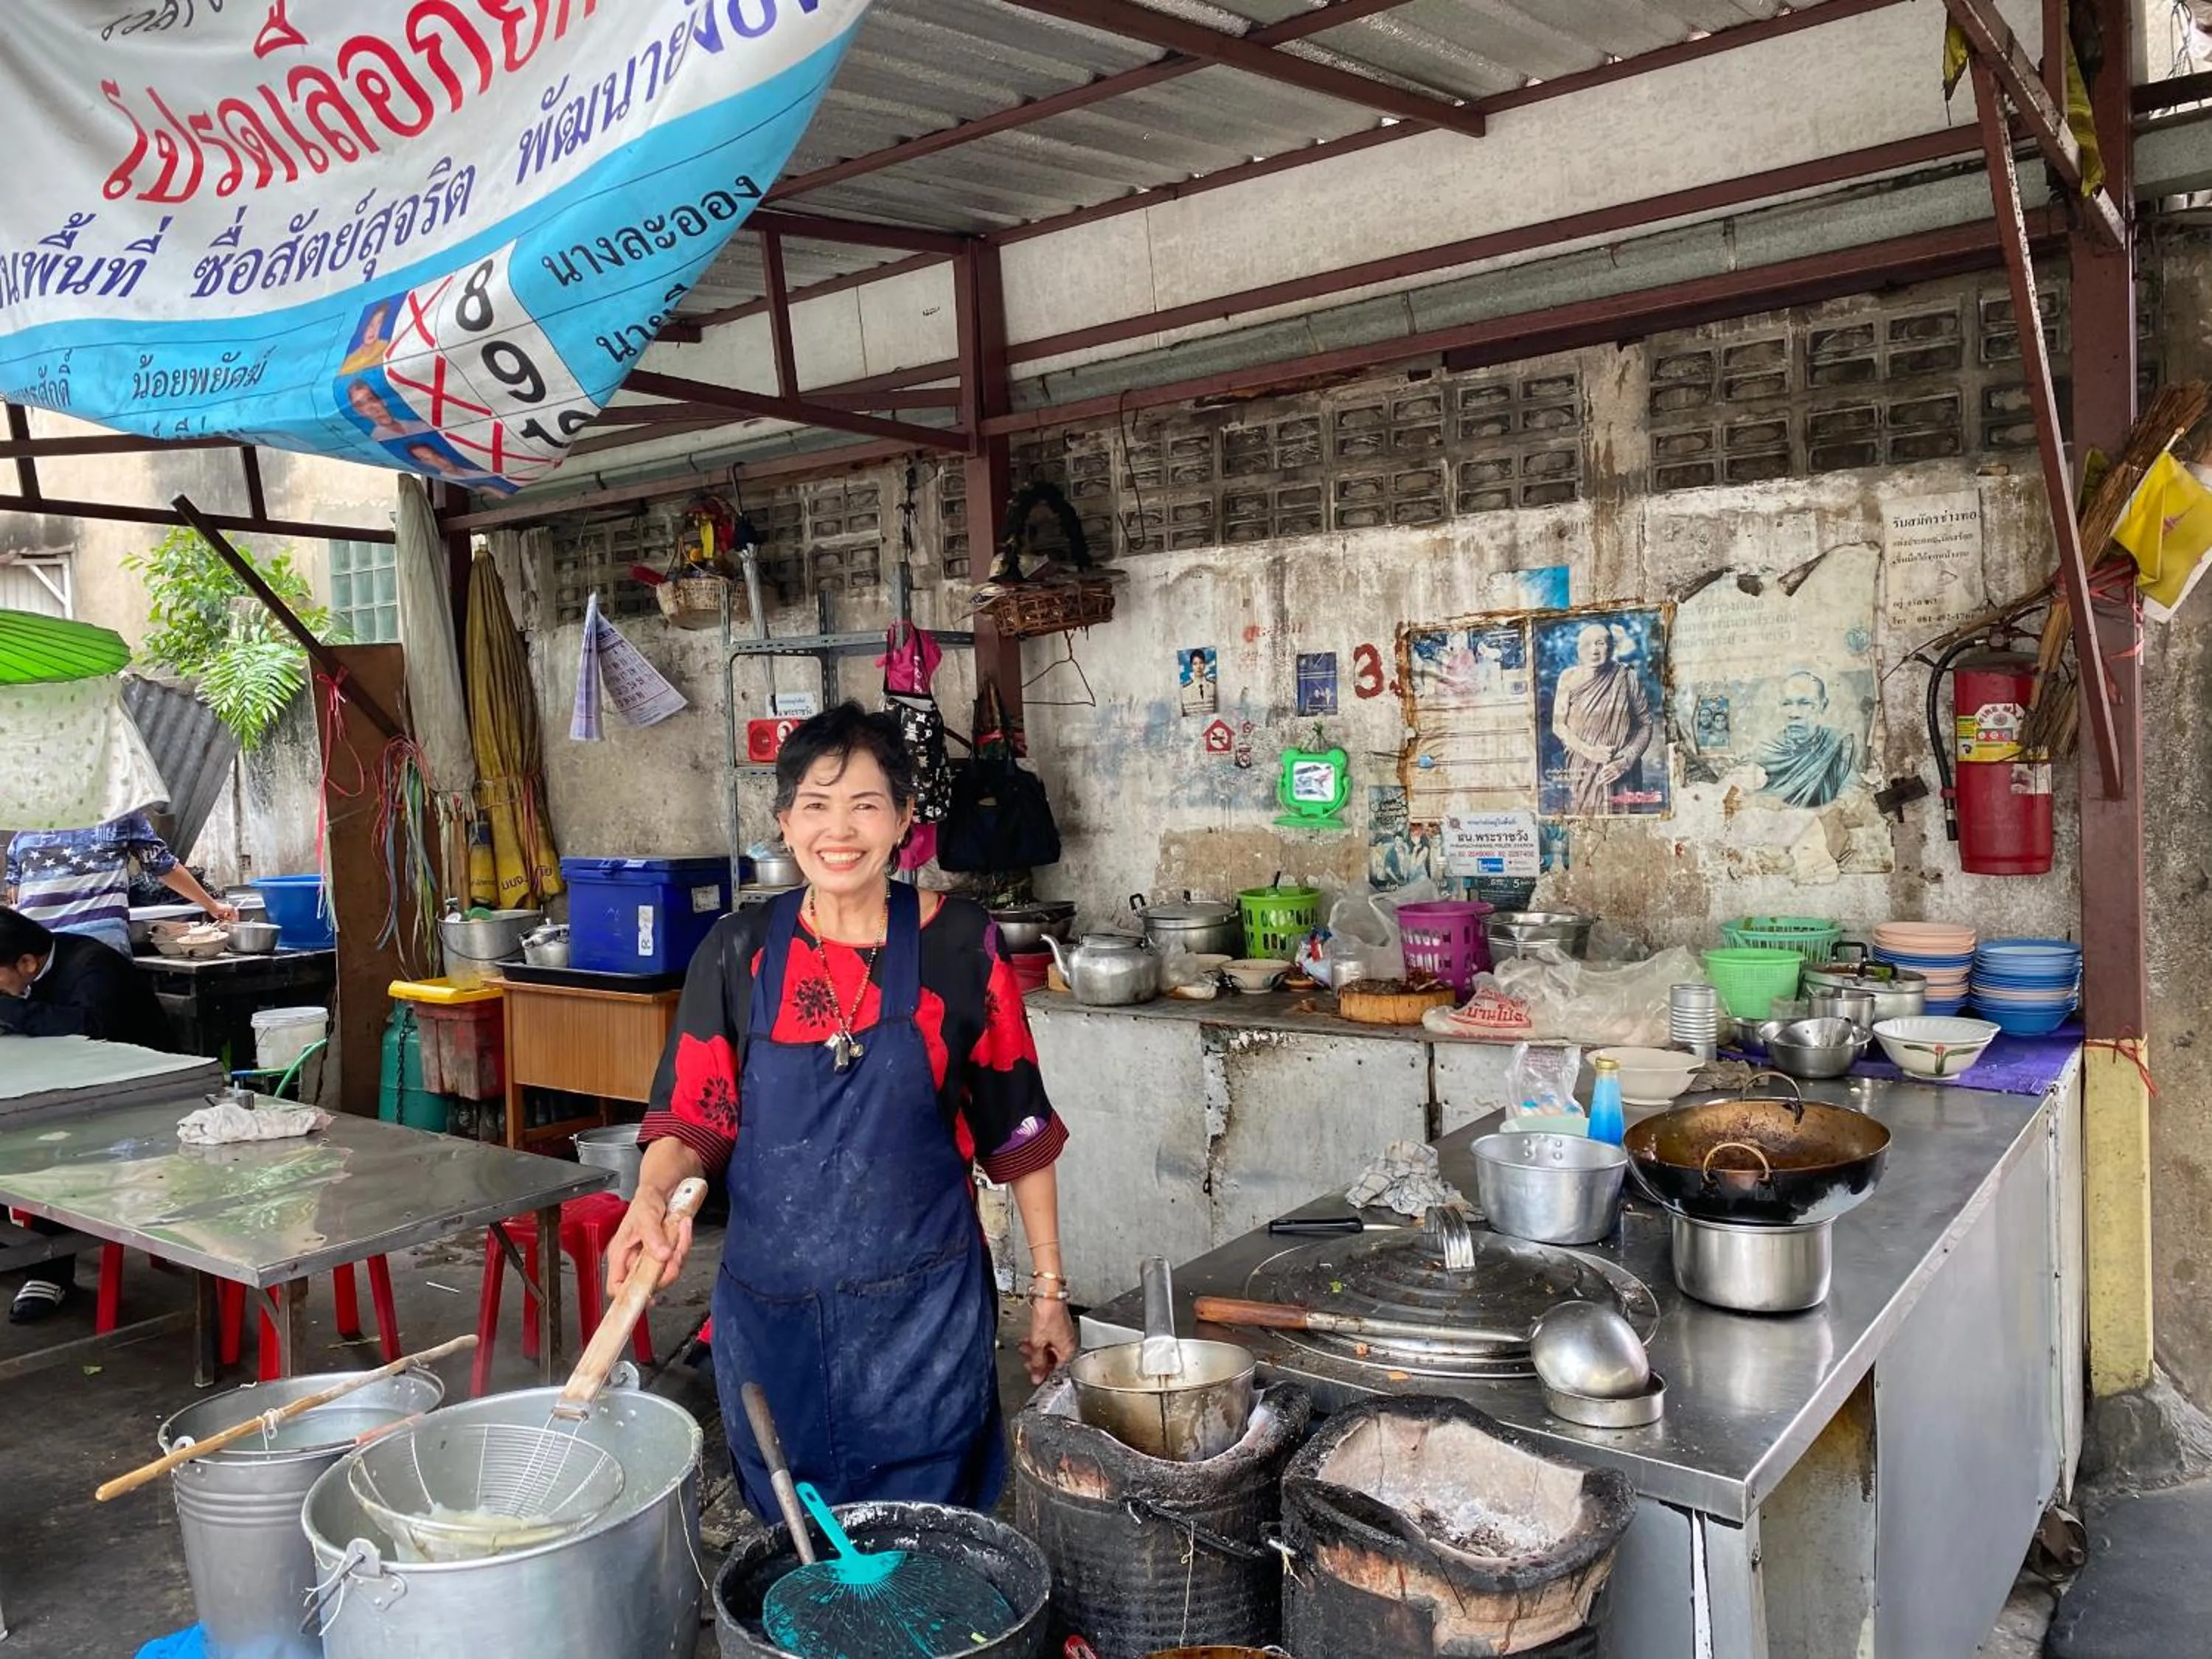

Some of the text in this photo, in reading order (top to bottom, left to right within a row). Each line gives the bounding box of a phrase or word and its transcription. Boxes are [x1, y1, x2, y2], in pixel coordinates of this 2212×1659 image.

[0, 212, 174, 309] นพื้นที่
[190, 156, 477, 298] ซื่อสัตย์สุจริต
[540, 173, 763, 287] นางละออง
[455, 260, 495, 332] 8
[480, 340, 547, 403] 9
